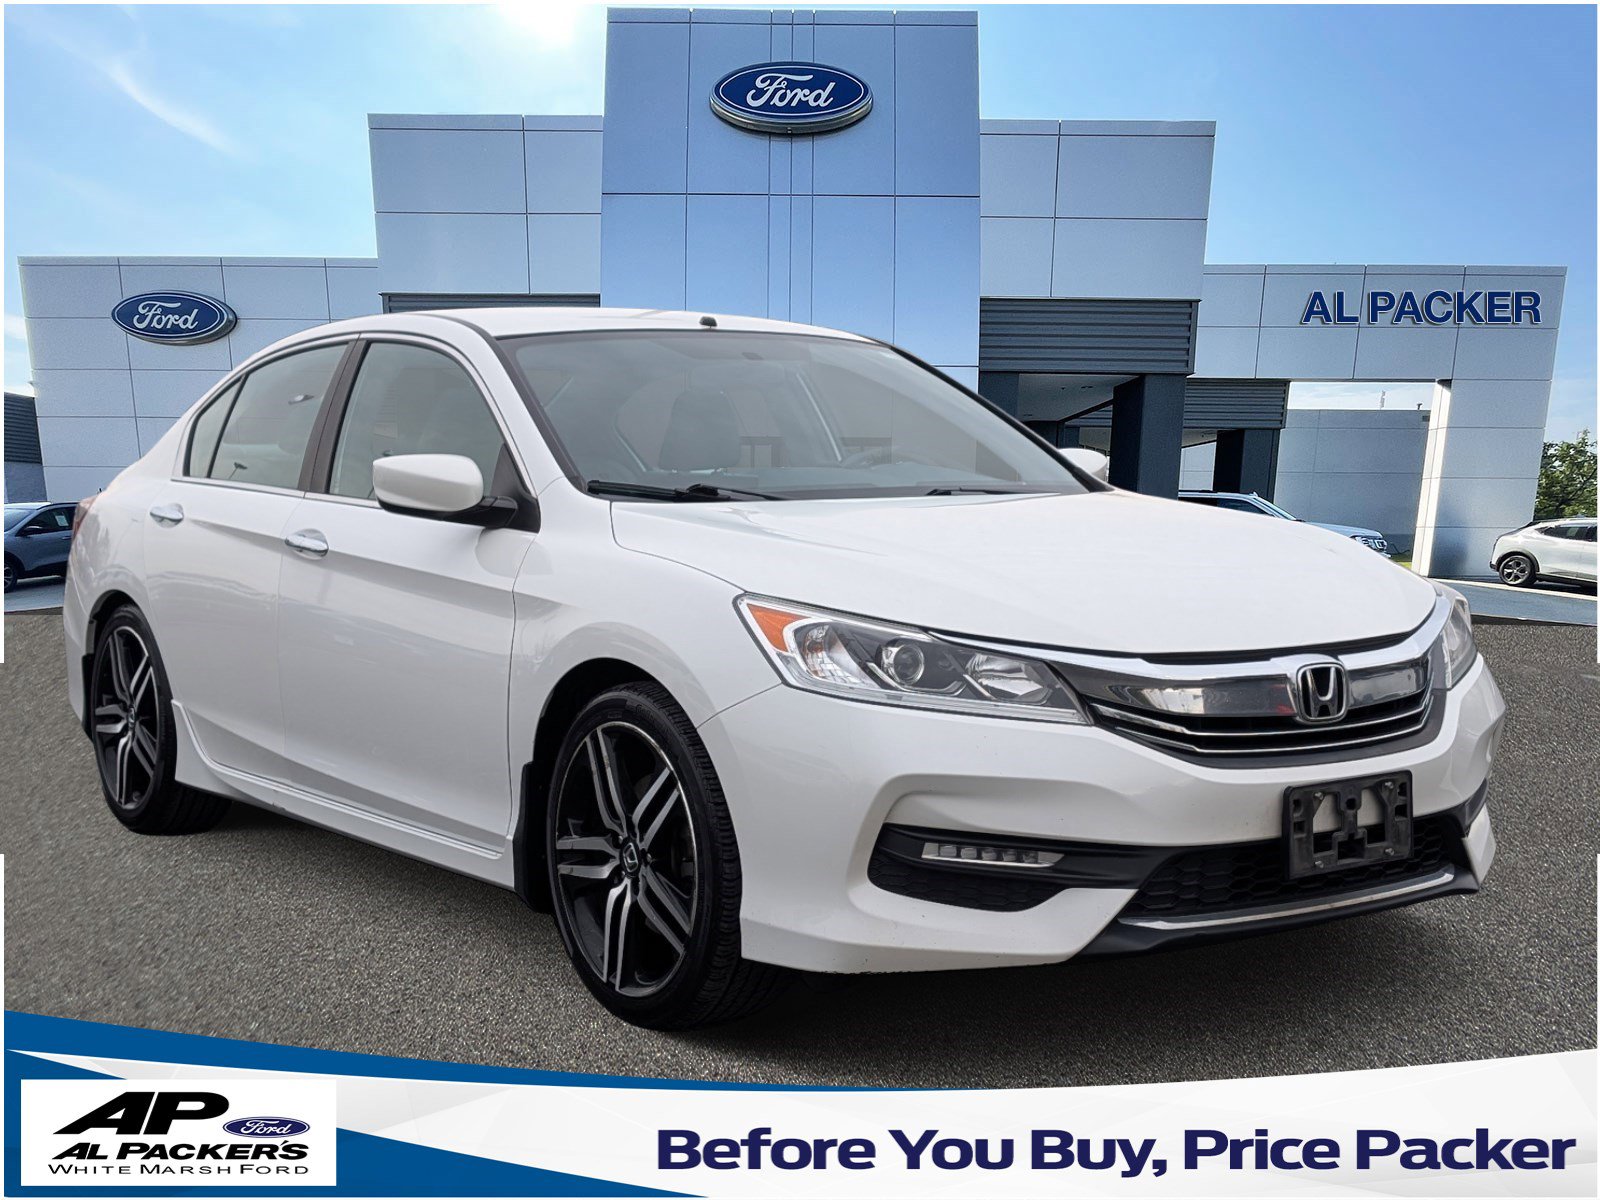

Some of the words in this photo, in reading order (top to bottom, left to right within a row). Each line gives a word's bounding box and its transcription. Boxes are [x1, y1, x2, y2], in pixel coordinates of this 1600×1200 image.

[746, 73, 836, 107] Ford
[133, 301, 199, 329] Ford
[1301, 290, 1359, 324] AL
[1368, 290, 1542, 325] PACKER
